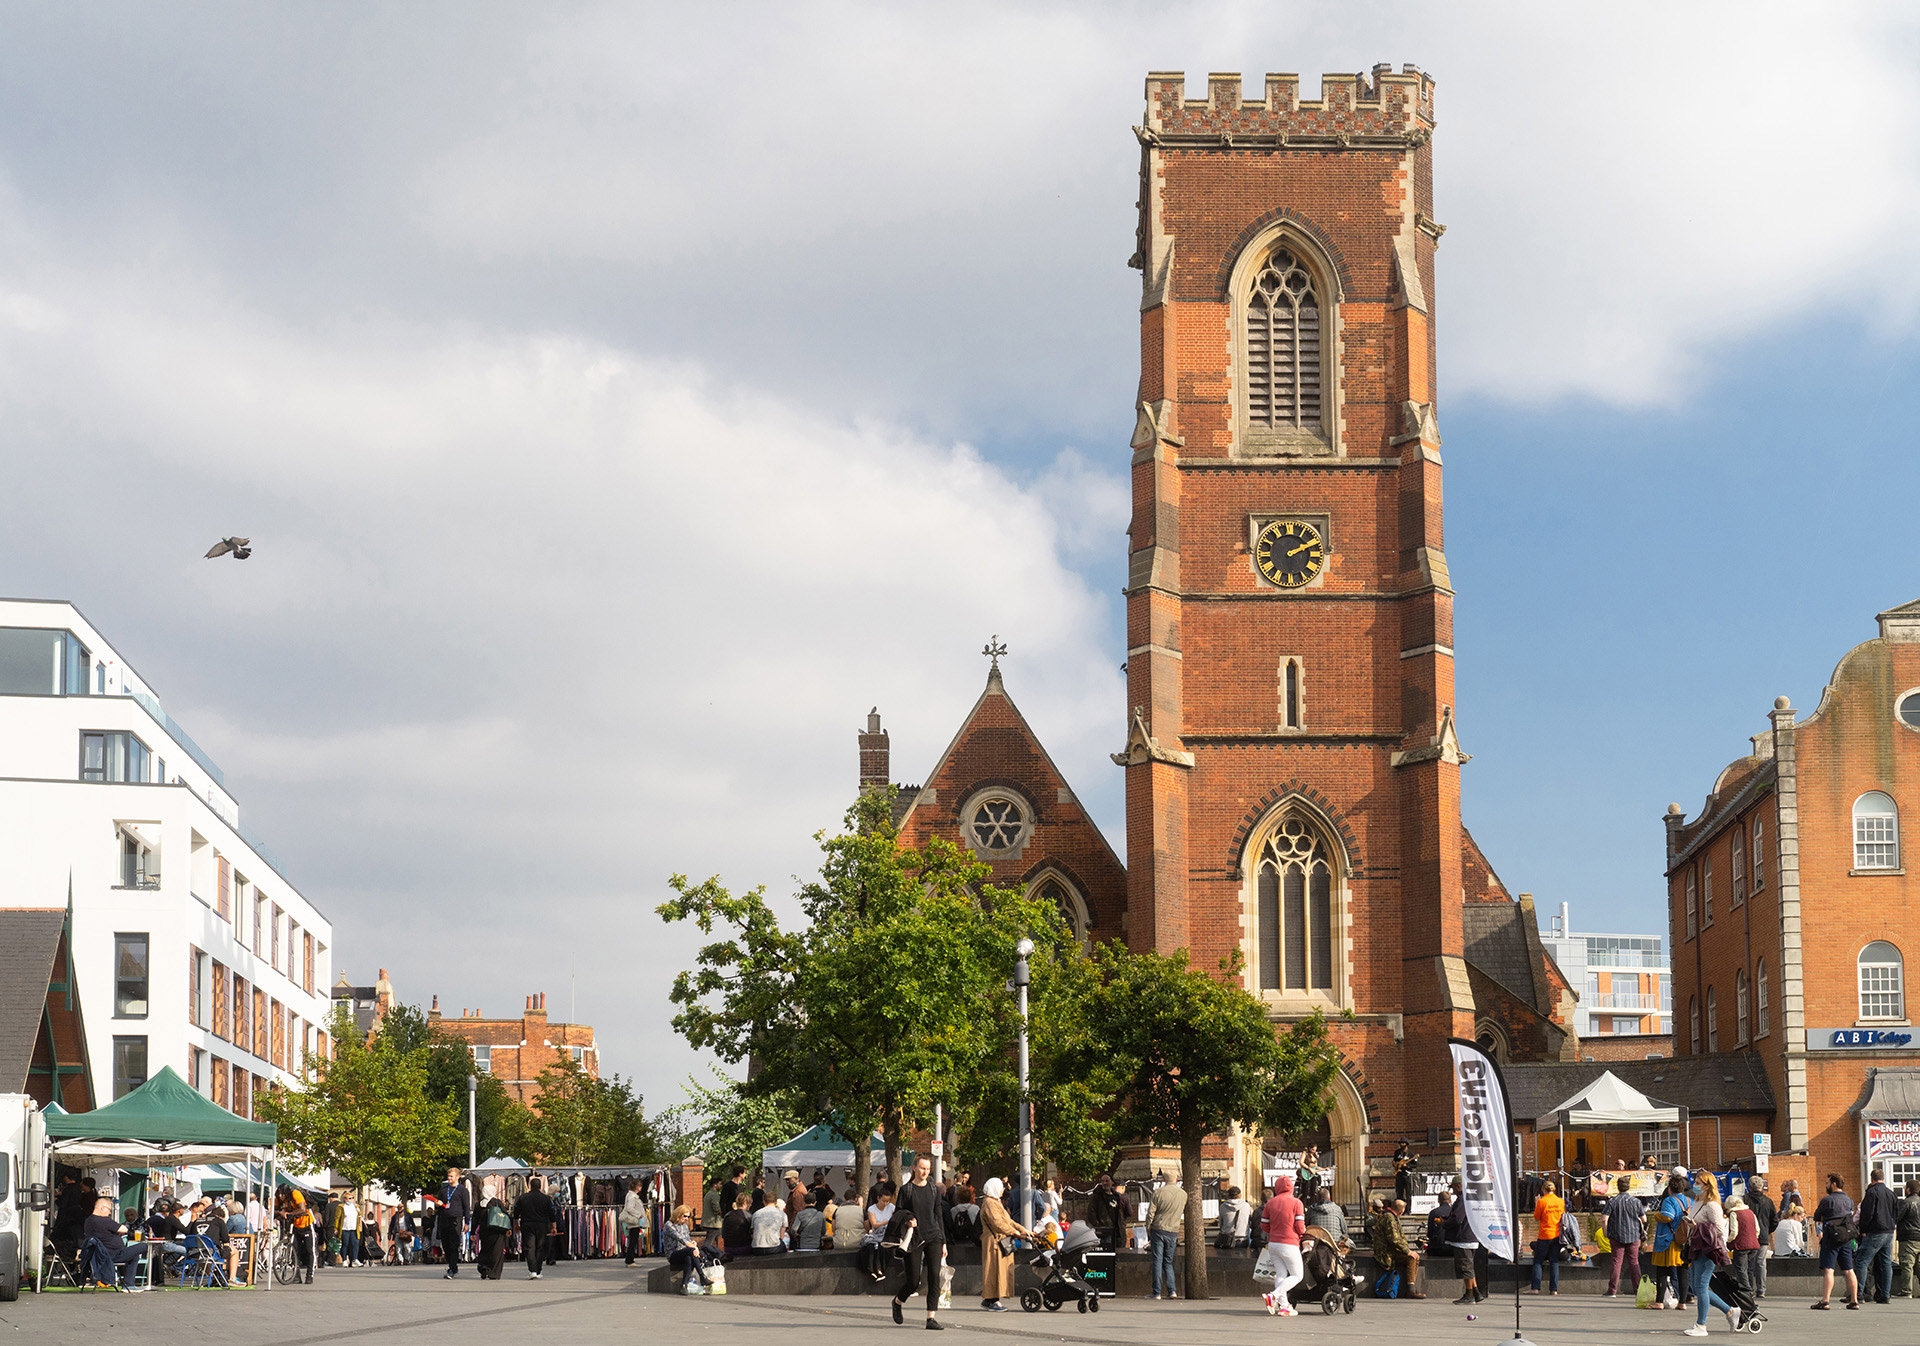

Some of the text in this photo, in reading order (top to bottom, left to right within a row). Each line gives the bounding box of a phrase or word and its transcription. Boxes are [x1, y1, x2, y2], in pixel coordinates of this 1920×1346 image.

[1836, 1031, 1912, 1045] ABI College
[1880, 1123, 1918, 1133] ENGLISH
[1876, 1133, 1920, 1142] LANGUAG
[1880, 1143, 1920, 1152] COURSES
